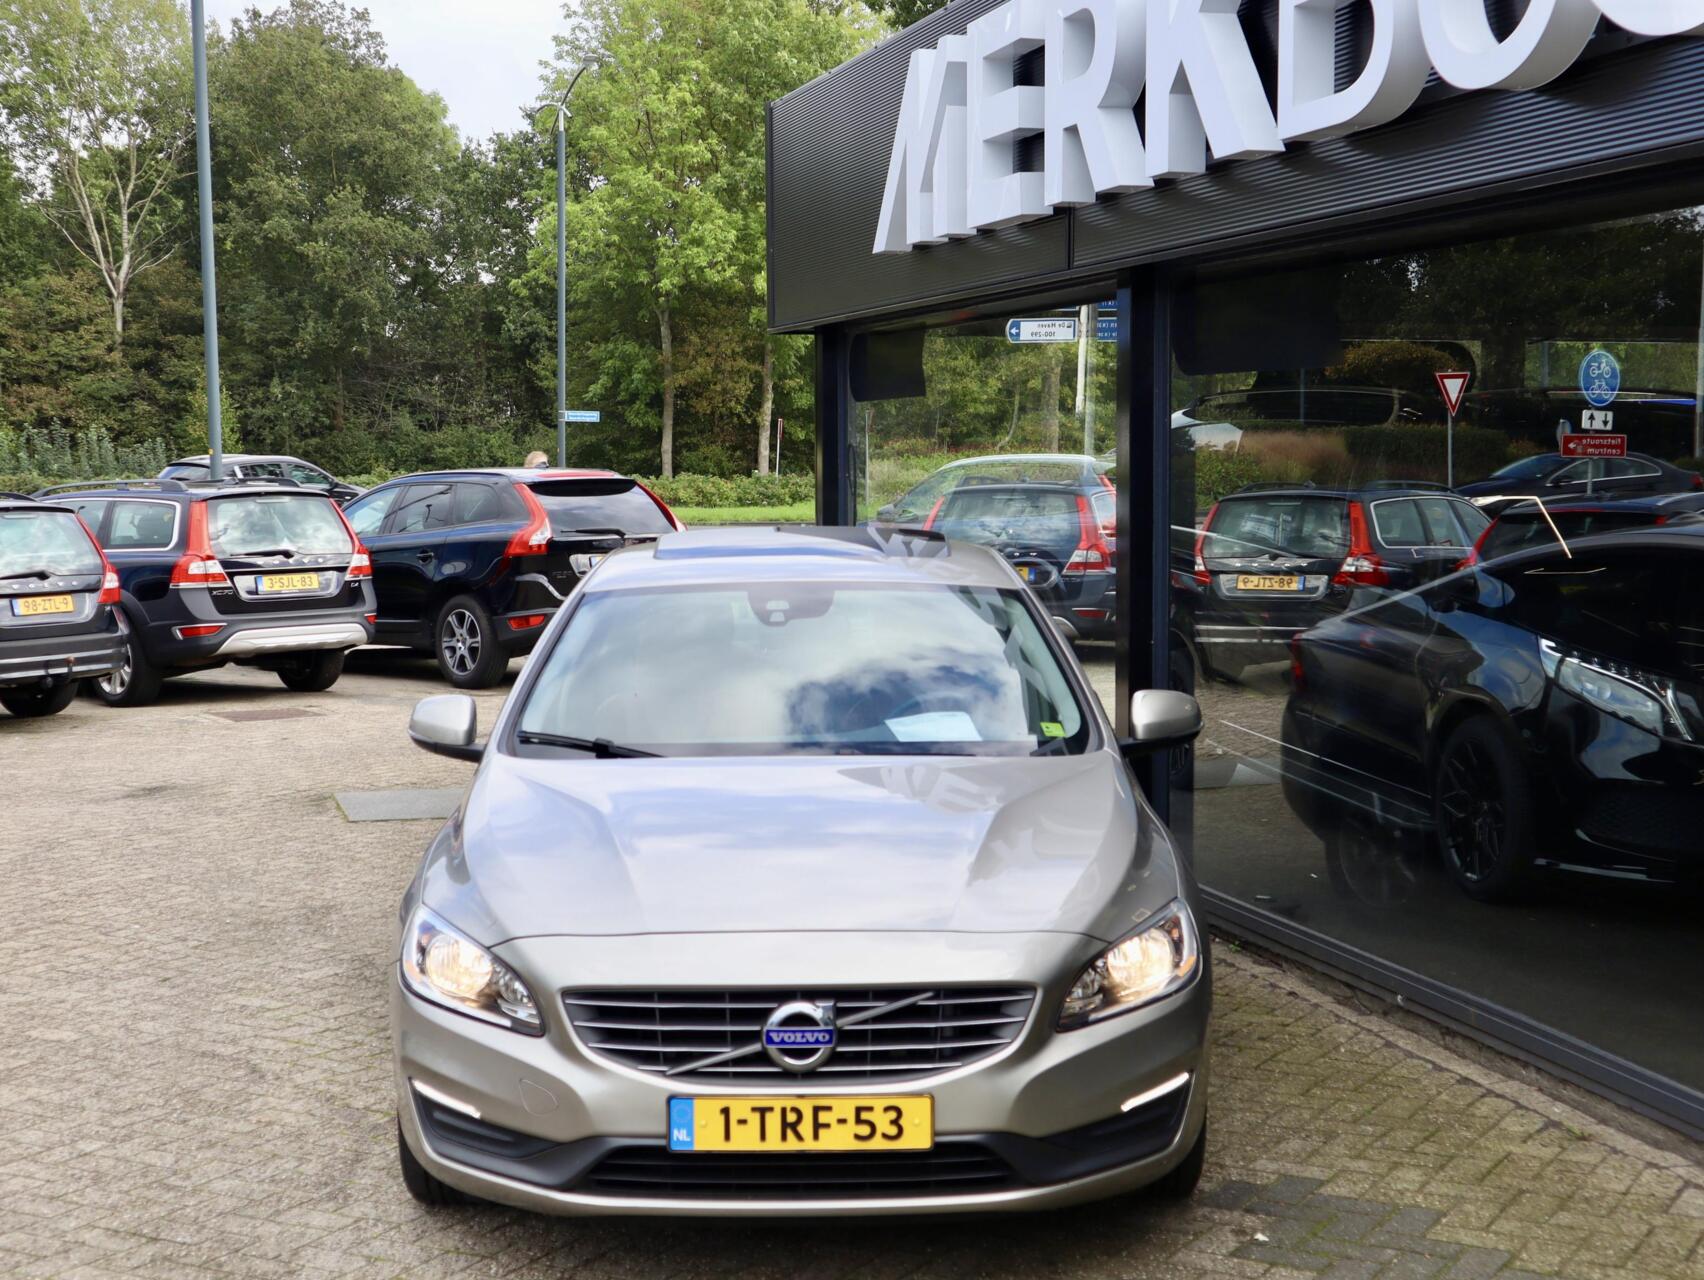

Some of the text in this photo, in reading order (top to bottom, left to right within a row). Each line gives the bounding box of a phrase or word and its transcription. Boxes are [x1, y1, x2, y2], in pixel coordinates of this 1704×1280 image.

[267, 575, 314, 589] 3-SJL-83
[23, 597, 69, 613] 98-ZTL-9
[769, 1031, 830, 1043] VOLVO
[719, 1105, 905, 1143] 1-TRF-53
[673, 1128, 691, 1143] NL
